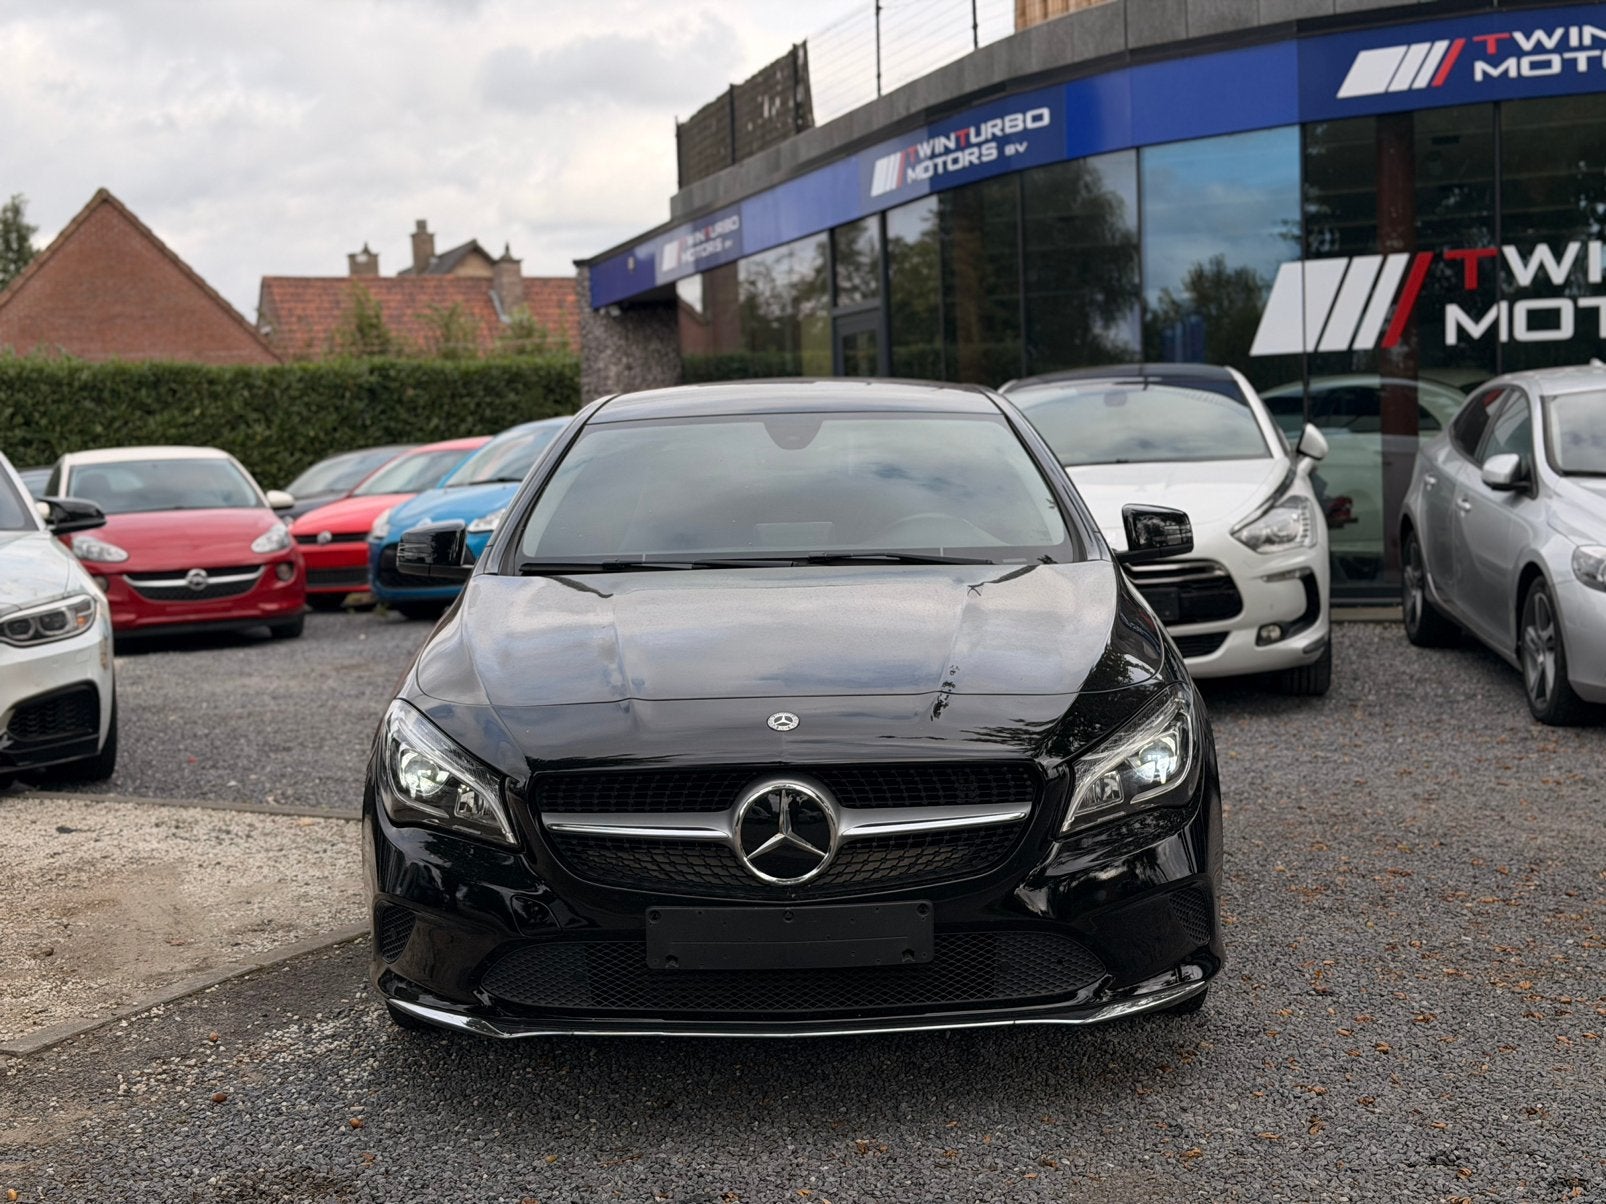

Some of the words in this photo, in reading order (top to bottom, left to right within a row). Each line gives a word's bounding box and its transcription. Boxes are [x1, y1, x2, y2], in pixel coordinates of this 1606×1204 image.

[1474, 49, 1606, 82] MOT
[908, 107, 1050, 161] TWINTURBO
[907, 142, 998, 184] MOTORS
